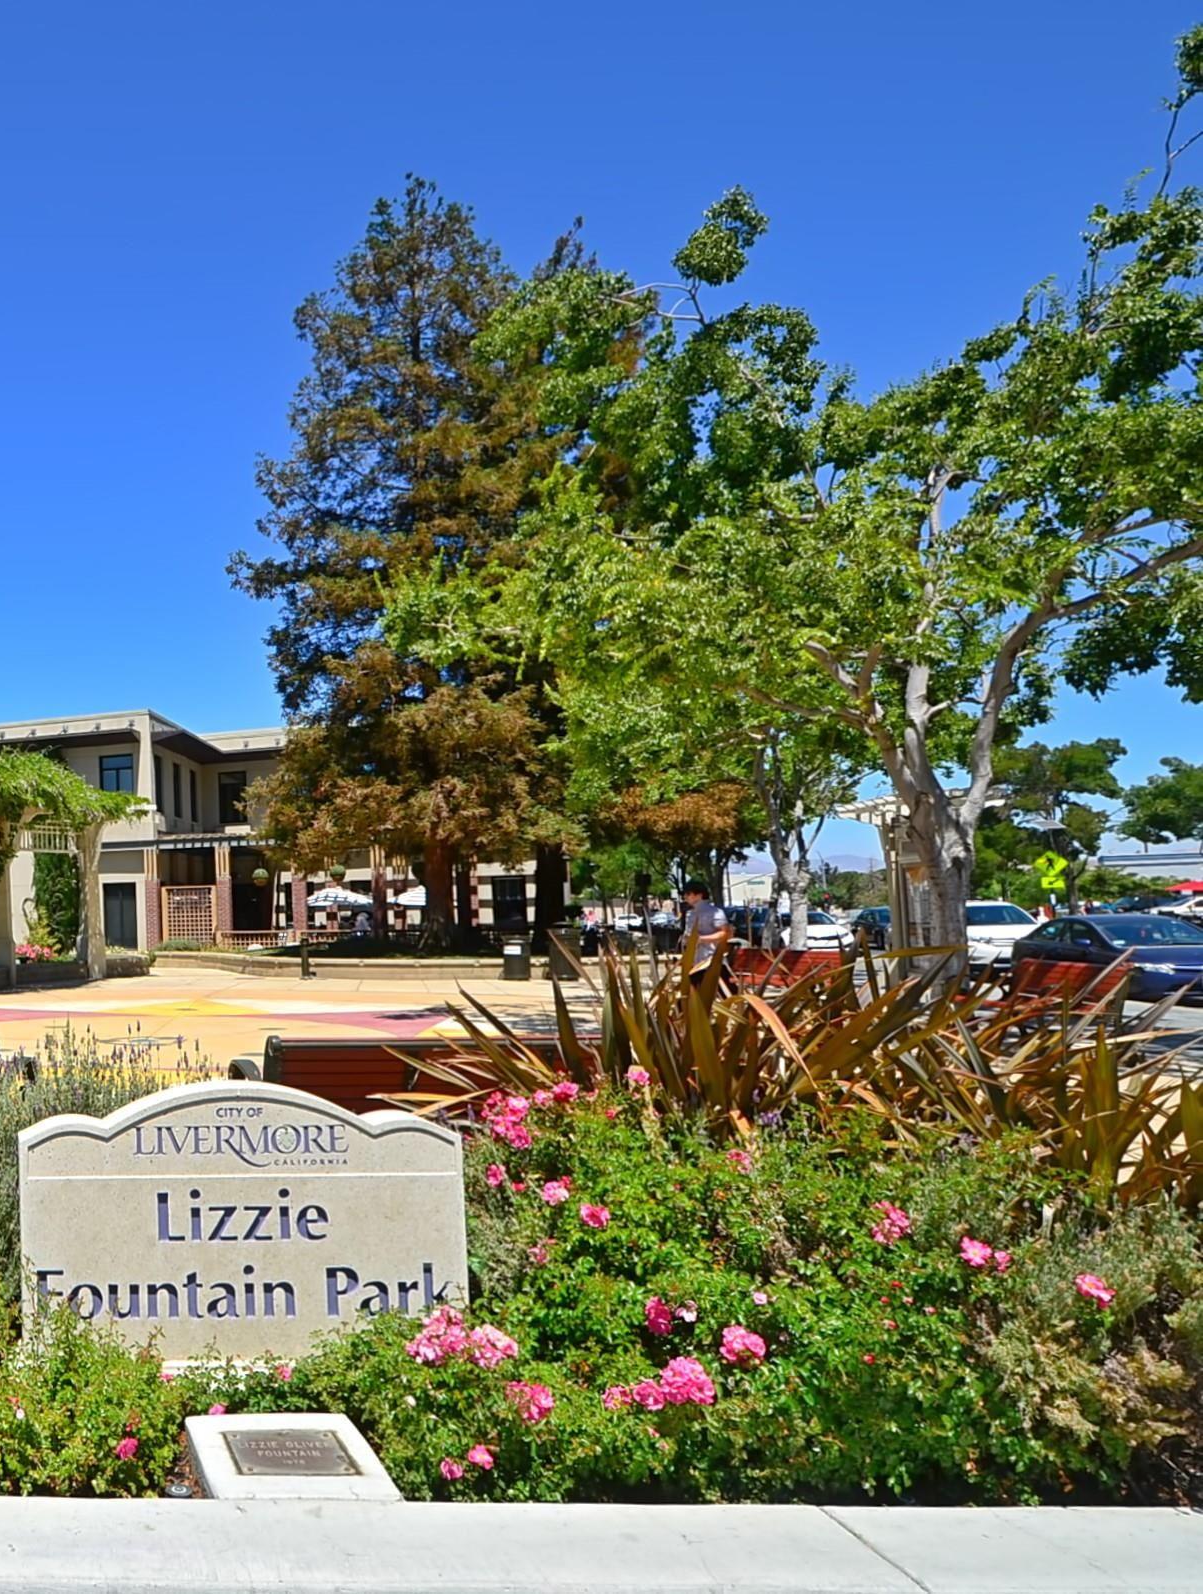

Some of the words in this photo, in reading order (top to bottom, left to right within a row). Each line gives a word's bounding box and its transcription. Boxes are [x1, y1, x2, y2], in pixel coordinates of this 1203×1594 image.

[216, 1107, 242, 1118] CITY
[246, 1107, 263, 1118] OF
[133, 1124, 349, 1167] LIVERMORE
[157, 1188, 329, 1241] Lizzie
[36, 1264, 296, 1319] Fountain
[326, 1263, 453, 1317] Park
